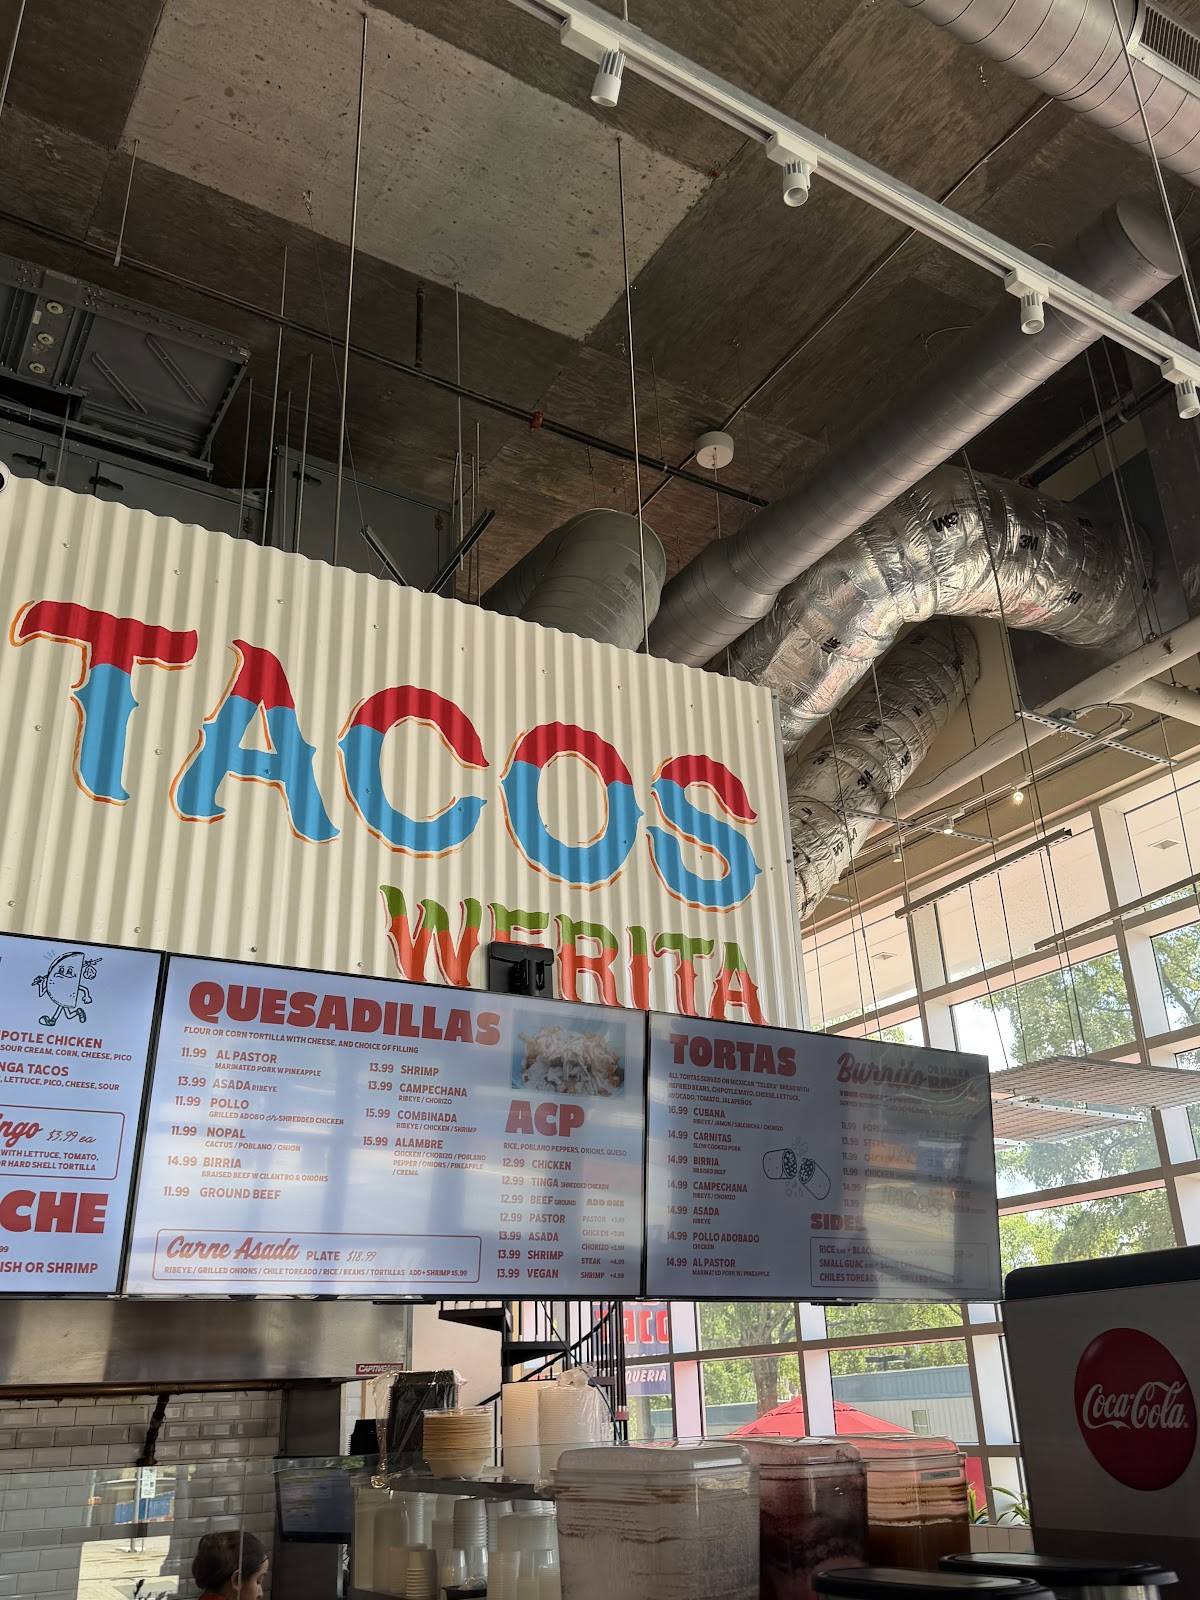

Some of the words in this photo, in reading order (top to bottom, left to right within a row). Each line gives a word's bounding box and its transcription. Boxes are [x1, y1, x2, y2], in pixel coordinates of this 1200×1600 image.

[1018, 534, 1039, 550] 3M
[9, 599, 763, 914] TACOS
[189, 981, 500, 1046] QUESADILLAS
[0, 1030, 44, 1043] POTLE
[47, 1034, 103, 1049] CHICKEN
[184, 1026, 211, 1035] FLOUR
[212, 1028, 224, 1036] OR
[225, 1030, 247, 1038] CORN
[249, 1032, 286, 1042] TORTILLA
[286, 1035, 306, 1044] WITH
[338, 1040, 353, 1048] AND
[355, 1042, 380, 1050] CHOICE
[392, 1045, 418, 1053] FILLING
[0, 1044, 23, 1052] SOUR
[113, 1053, 132, 1061] PICO
[181, 1046, 207, 1058] 11.99
[216, 1049, 231, 1060] AL
[232, 1050, 277, 1064] PASTOR
[670, 1033, 797, 1077] TORTAS
[28, 1063, 69, 1076] TACOS
[215, 1062, 256, 1072] MARINATED
[257, 1065, 277, 1073] PORK
[369, 1063, 394, 1073] 13.99
[400, 1065, 439, 1076] SHRIMP
[98, 1083, 120, 1091] SOUR
[178, 1076, 206, 1087] 13.99
[213, 1078, 250, 1091] ASADA
[368, 1081, 392, 1091] 13.99
[400, 1083, 467, 1097] CAMPECHANA
[175, 1096, 200, 1106] 11.99
[210, 1098, 249, 1110] POLLO
[398, 1095, 421, 1103] RIBEYE
[209, 1111, 239, 1119] GRILLED
[315, 1117, 345, 1125] CHICKEN
[366, 1108, 390, 1118] 15.99
[397, 1110, 457, 1123] COMBINADA
[504, 1100, 585, 1137] ACP
[668, 1106, 688, 1115] 16.99
[693, 1107, 726, 1119] CUBANA
[0, 1113, 44, 1148] ngo
[79, 1135, 97, 1143] ea
[171, 1125, 197, 1136] 11.99
[207, 1127, 246, 1138] NOPAL
[423, 1124, 450, 1132] CHICKEN
[363, 1136, 388, 1146] 15.99
[395, 1138, 443, 1149] ALAMBRE
[668, 1130, 688, 1139] 14.99
[693, 1132, 732, 1142] CARNITAS
[205, 1140, 234, 1149] CACTUS
[238, 1142, 272, 1150] POBLANO
[8, 1160, 30, 1168] HARD
[31, 1161, 57, 1169] SHELL
[58, 1162, 96, 1171] TORTILLA
[167, 1155, 197, 1167] 14.99
[203, 1157, 241, 1169] BIRRIA
[502, 1158, 525, 1167] 12.99
[532, 1160, 571, 1171] CHICKEN
[668, 1155, 688, 1164] 14.99
[693, 1156, 719, 1166] BIRRIA
[201, 1170, 232, 1179] BRAISED
[501, 1176, 524, 1185] 12.99
[531, 1178, 559, 1188] TINGA
[668, 1180, 688, 1189] 14.99
[693, 1181, 747, 1192] CAMPECHANA
[163, 1186, 190, 1197] 11.99
[200, 1187, 250, 1199] GROUND
[253, 1189, 281, 1200] BEEF
[501, 1194, 524, 1204] 12.99
[530, 1195, 554, 1205] BEEF
[0, 1189, 109, 1234] CHE
[500, 1212, 522, 1222] 12.99
[529, 1213, 566, 1223] PASTOR
[693, 1206, 720, 1216] ASADA
[810, 1213, 867, 1231] SIDES
[499, 1231, 521, 1241] 13.99
[528, 1232, 559, 1242] ASADA
[667, 1232, 687, 1240] 14.99
[693, 1232, 720, 1241] POLLO
[721, 1233, 760, 1243] ADOBADO
[166, 1235, 231, 1260] Carne
[233, 1236, 300, 1260] Asada
[306, 1250, 340, 1261] PLATE
[347, 1251, 376, 1262] $18.99
[497, 1250, 520, 1260] 13.99
[527, 1251, 564, 1260] SHRIMP
[25, 1262, 44, 1272] OR
[47, 1263, 98, 1274] SHRIMP
[666, 1257, 687, 1267] 14.99
[693, 1258, 703, 1267] AL
[704, 1258, 736, 1267] PASTOR
[497, 1268, 520, 1278] 13.99
[527, 1269, 559, 1279] VEGAN
[1082, 1381, 1186, 1430] Coca-Cola
